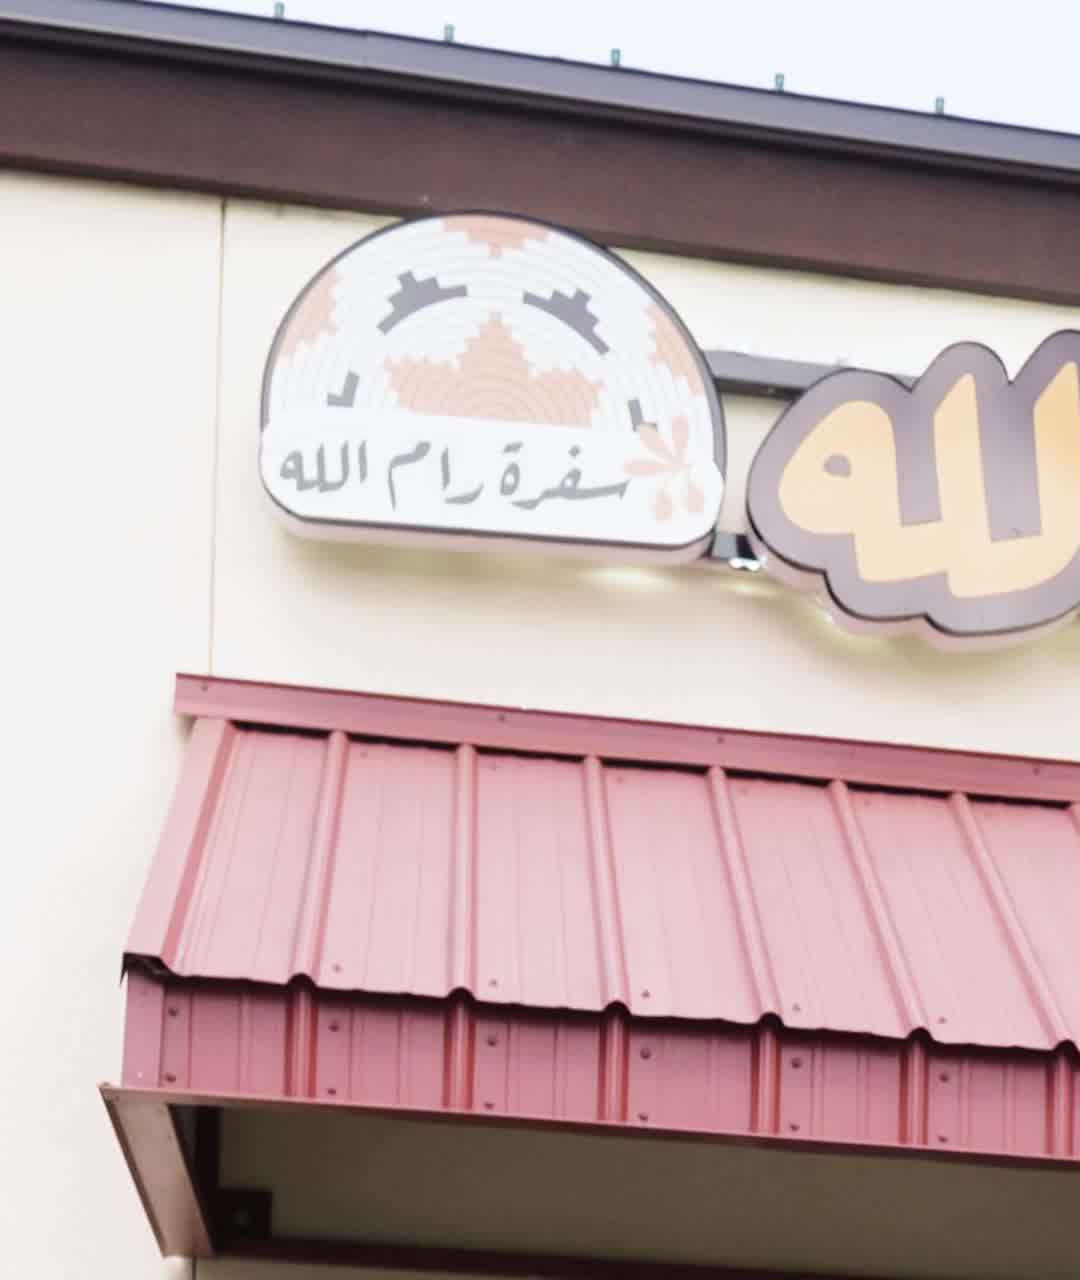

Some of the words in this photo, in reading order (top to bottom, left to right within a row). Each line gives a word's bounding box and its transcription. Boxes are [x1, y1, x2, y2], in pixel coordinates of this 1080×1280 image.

[279, 438, 369, 494] الله
[386, 440, 485, 512] رام
[500, 440, 632, 510] سفرة
